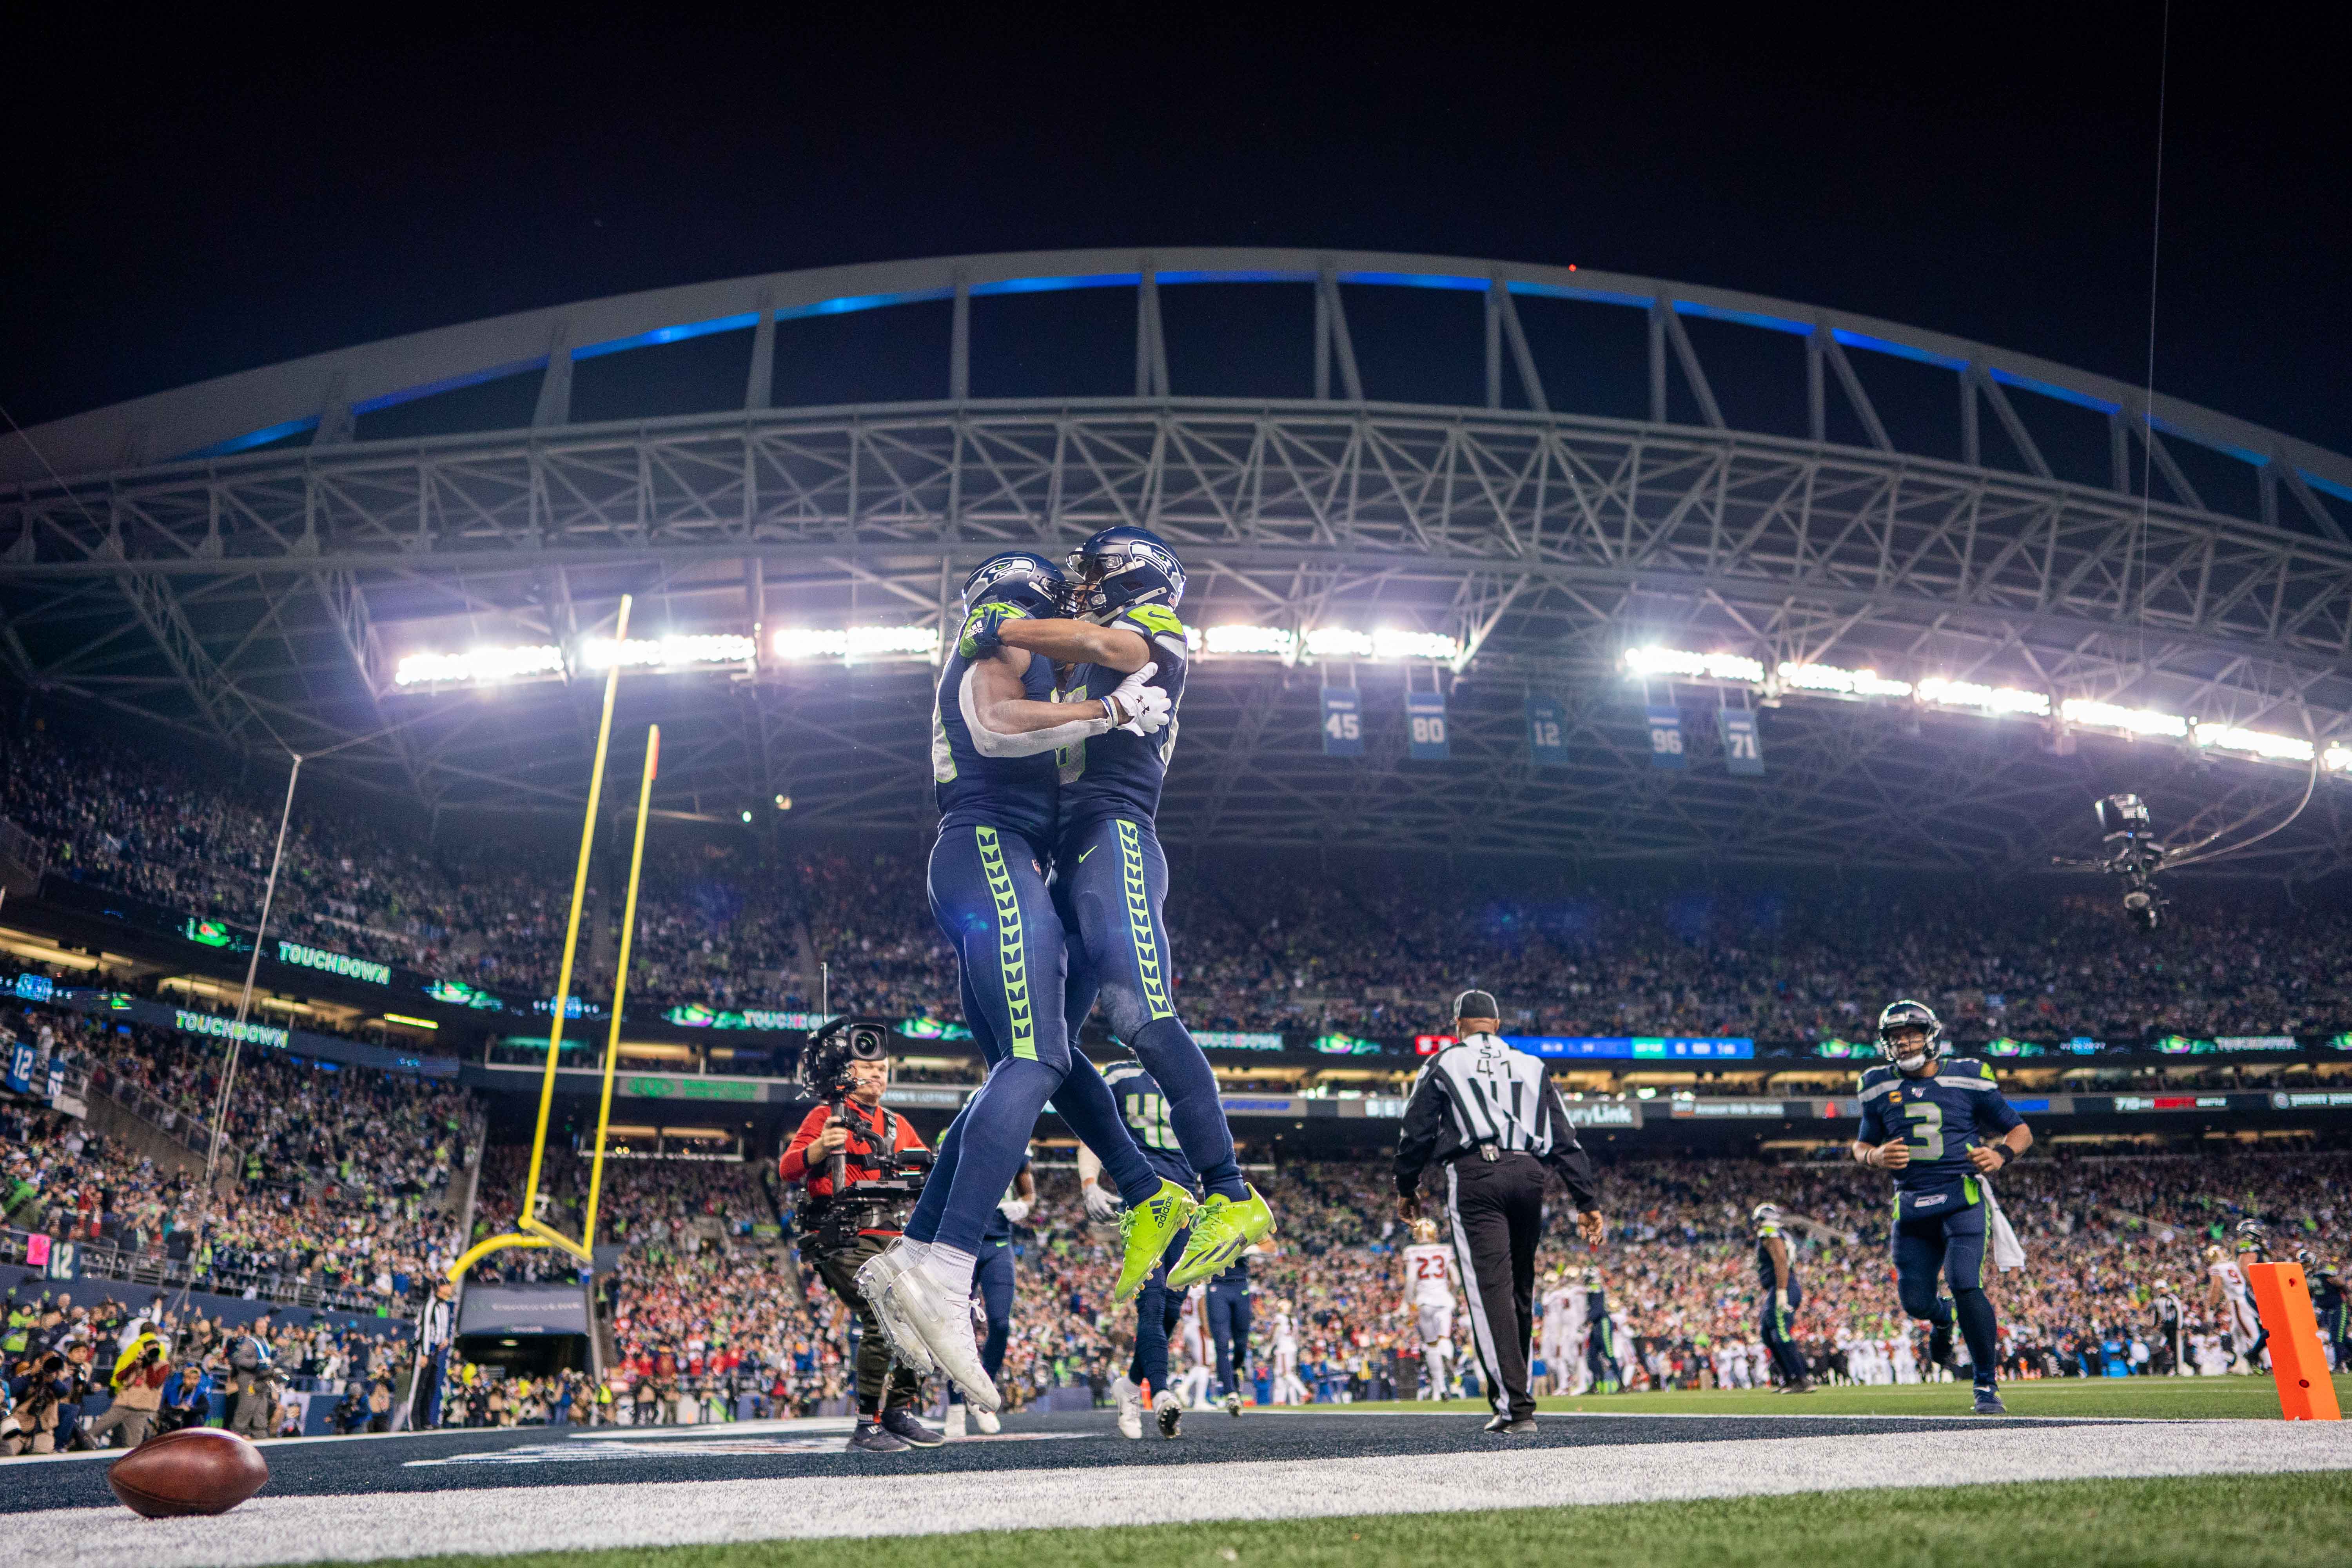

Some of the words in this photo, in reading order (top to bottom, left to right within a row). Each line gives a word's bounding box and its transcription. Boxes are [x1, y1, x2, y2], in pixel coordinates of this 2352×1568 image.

[1326, 713, 1359, 740] 45
[1413, 717, 1445, 743] 80
[1534, 721, 1561, 747] 12
[1651, 728, 1682, 754] 96
[1729, 733, 1757, 759] 71
[279, 941, 391, 984] TOUCHDOWN
[176, 1010, 288, 1048] TOUCHDOWN
[14, 1047, 33, 1081] 12
[1480, 1049, 1501, 1058] SJ
[1569, 1103, 1633, 1126] uryLink
[1904, 1102, 1944, 1160] 3
[1158, 1196, 1173, 1228] adidas
[51, 1242, 74, 1279] 12
[1417, 1255, 1445, 1279] 23
